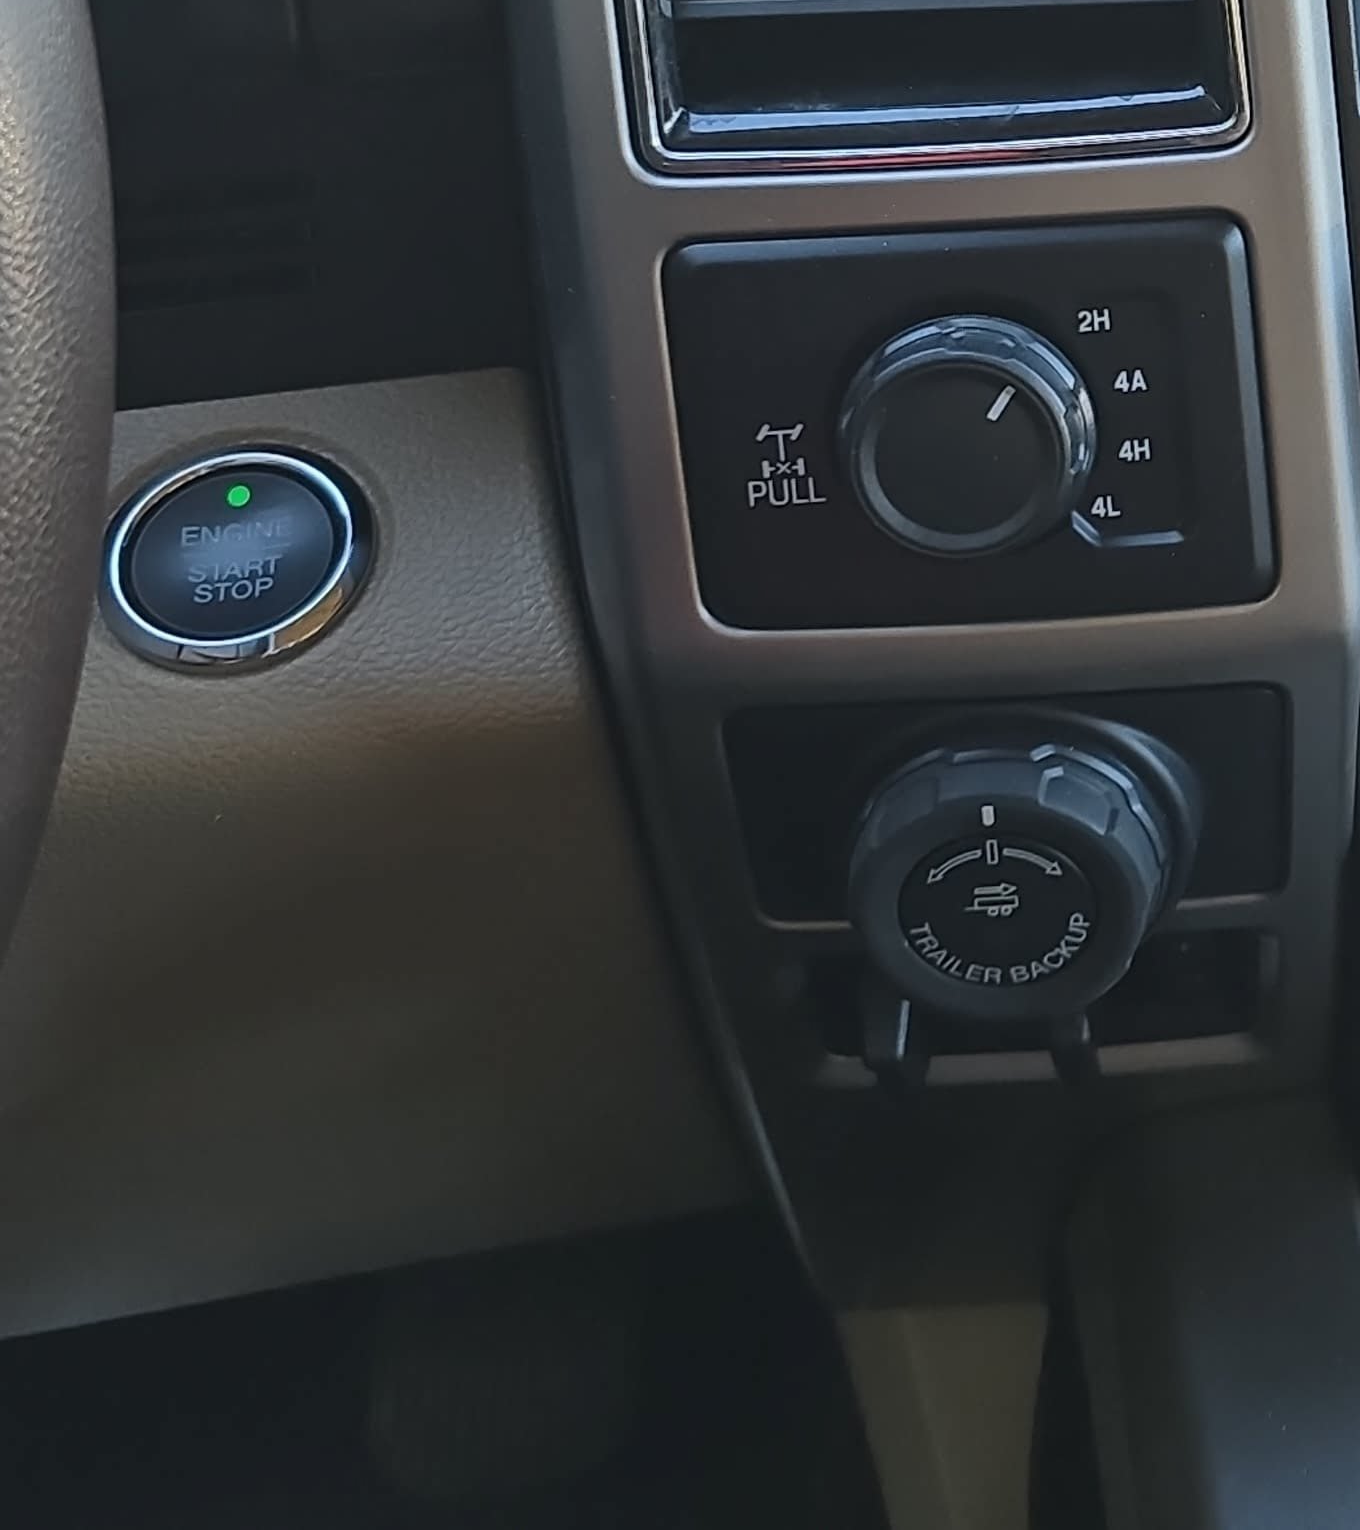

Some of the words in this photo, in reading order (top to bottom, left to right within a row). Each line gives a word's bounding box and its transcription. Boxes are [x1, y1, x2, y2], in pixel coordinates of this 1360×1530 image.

[1076, 307, 1112, 333] 2H
[1113, 369, 1148, 395] 4A
[1118, 437, 1152, 463] 4H
[746, 477, 827, 509] PULL
[1090, 495, 1121, 519] 4L
[187, 553, 284, 584] START
[192, 576, 275, 605] STOP
[908, 920, 1003, 986] TRAILER
[1009, 910, 1092, 984] BACKUP
